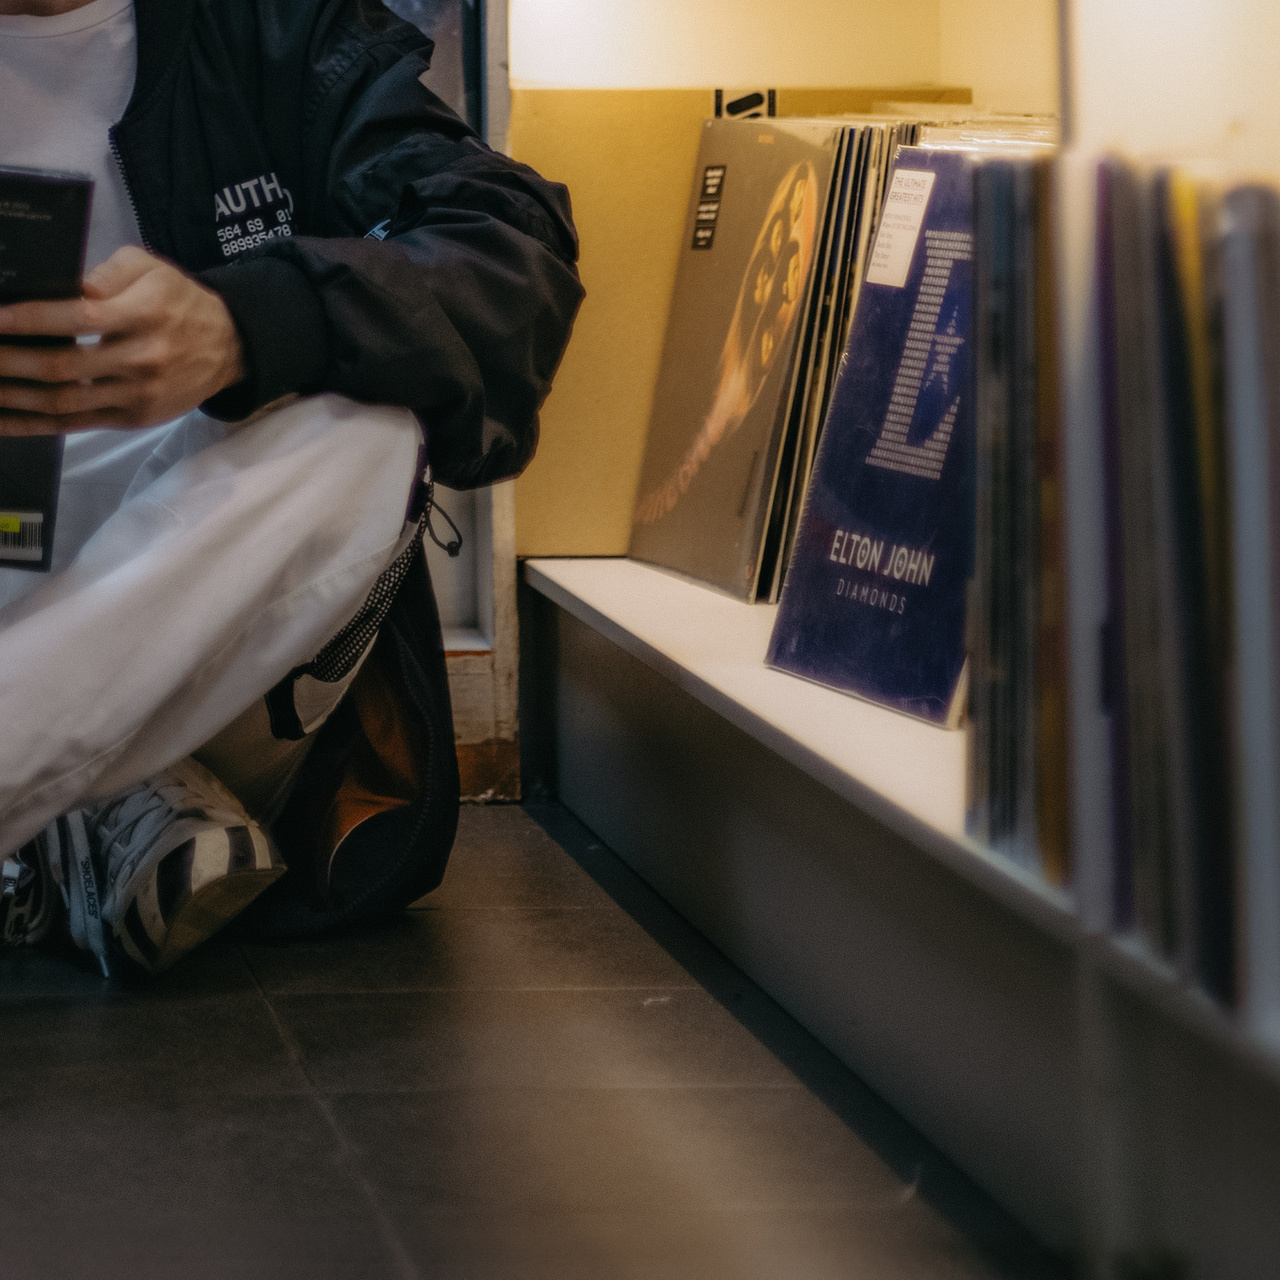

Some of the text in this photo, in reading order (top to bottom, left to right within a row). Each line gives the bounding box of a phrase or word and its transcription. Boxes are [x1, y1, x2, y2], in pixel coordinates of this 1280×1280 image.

[217, 224, 242, 242] 564
[246, 218, 264, 233] 69
[829, 528, 935, 588] ELTON JOHN
[836, 578, 907, 615] DIAMONDS
